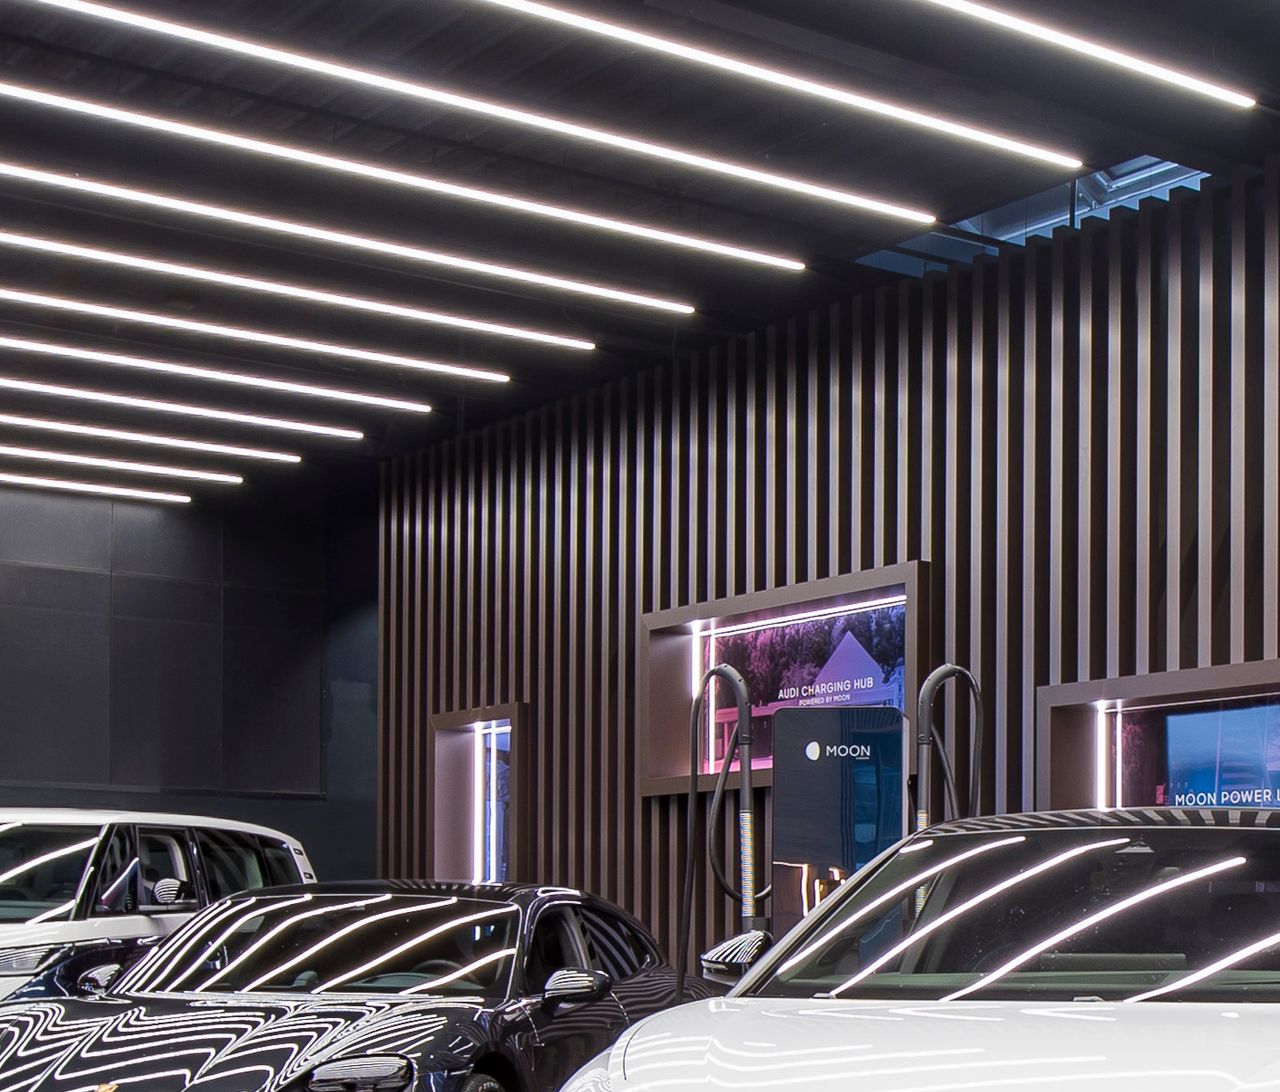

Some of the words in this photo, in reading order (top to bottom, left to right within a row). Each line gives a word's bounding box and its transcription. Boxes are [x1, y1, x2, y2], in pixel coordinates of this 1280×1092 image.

[778, 687, 799, 699] AUDI
[801, 680, 851, 697] CHARGING
[853, 677, 874, 689] HUB
[799, 697, 825, 706] POWERED
[833, 694, 851, 702] MOON
[825, 745, 871, 757] MOON
[1175, 793, 1217, 806] MOON
[1221, 789, 1272, 804] POWER
